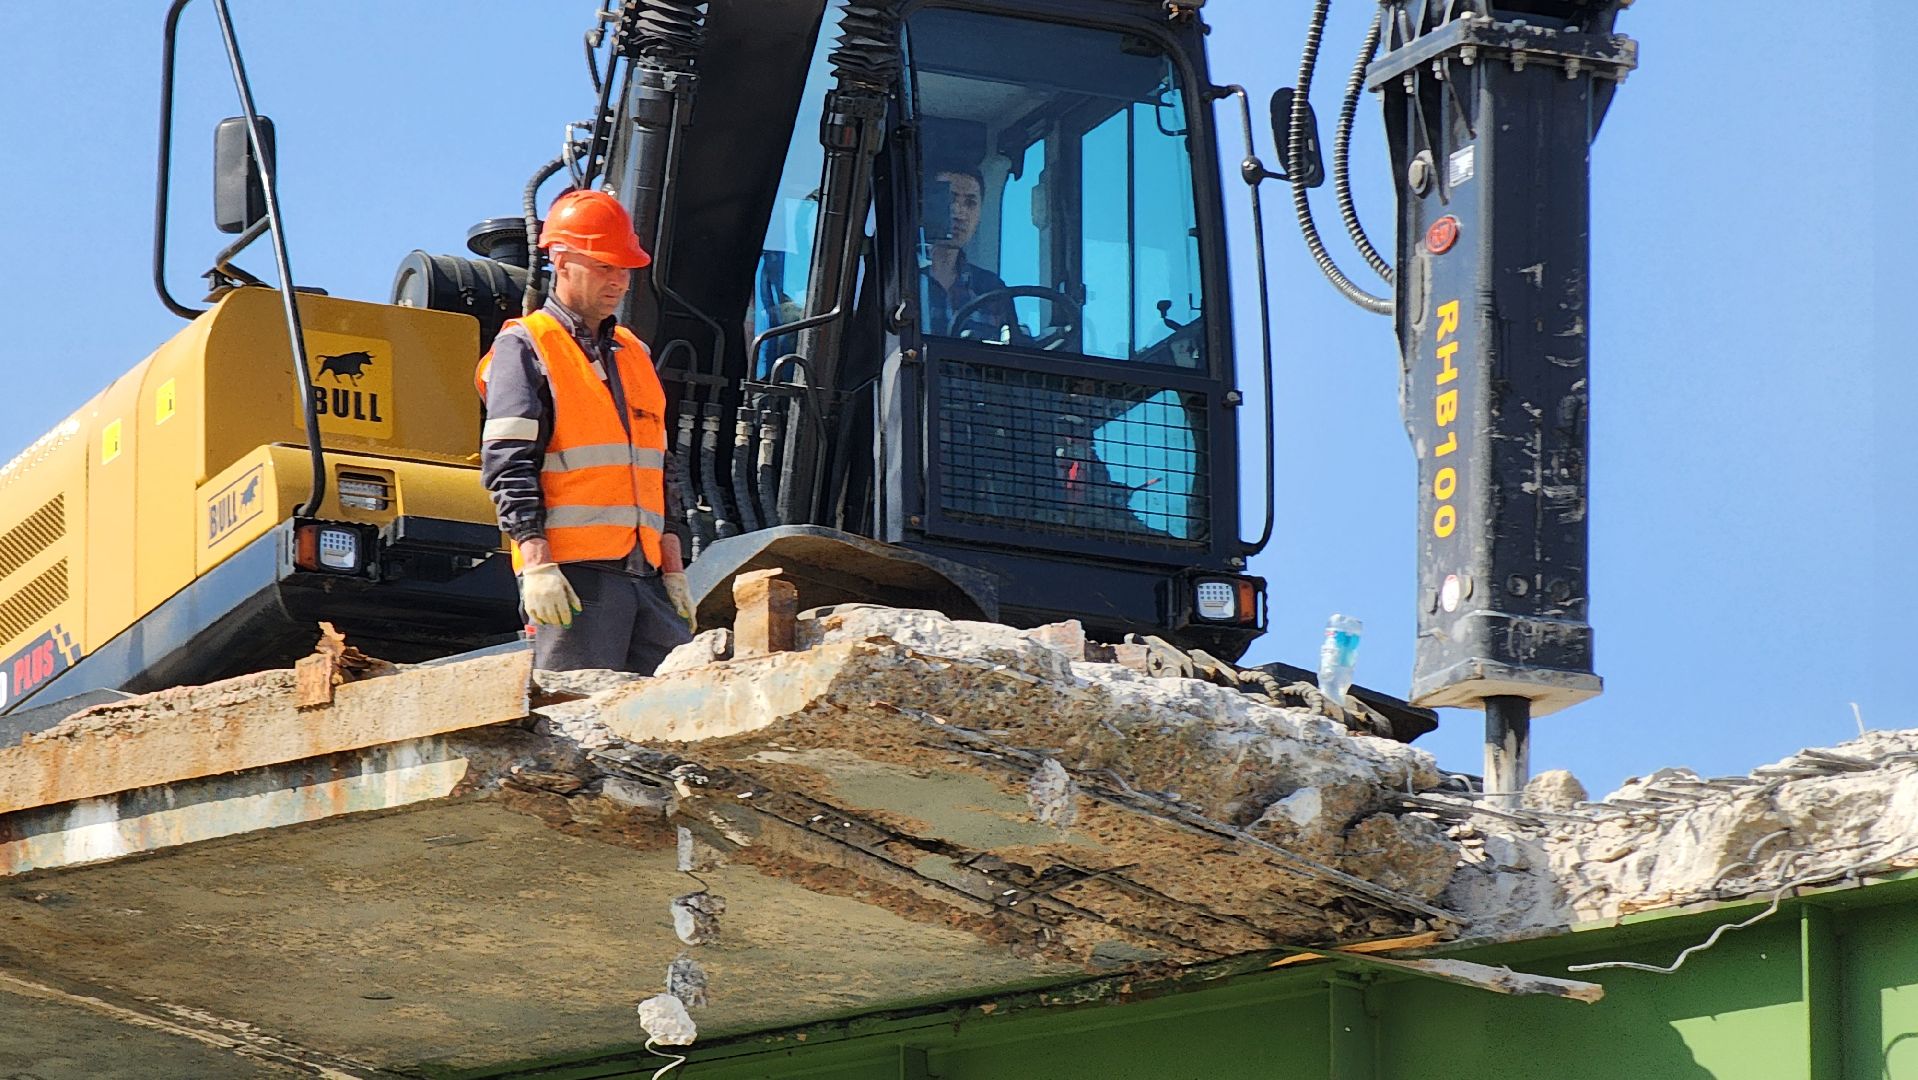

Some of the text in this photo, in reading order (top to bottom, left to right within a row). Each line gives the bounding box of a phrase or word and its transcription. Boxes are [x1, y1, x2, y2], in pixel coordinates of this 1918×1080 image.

[311, 386, 383, 422] BULL
[1433, 300, 1460, 538] RHB100
[209, 491, 237, 539] BULL
[13, 639, 54, 697] PLUS
